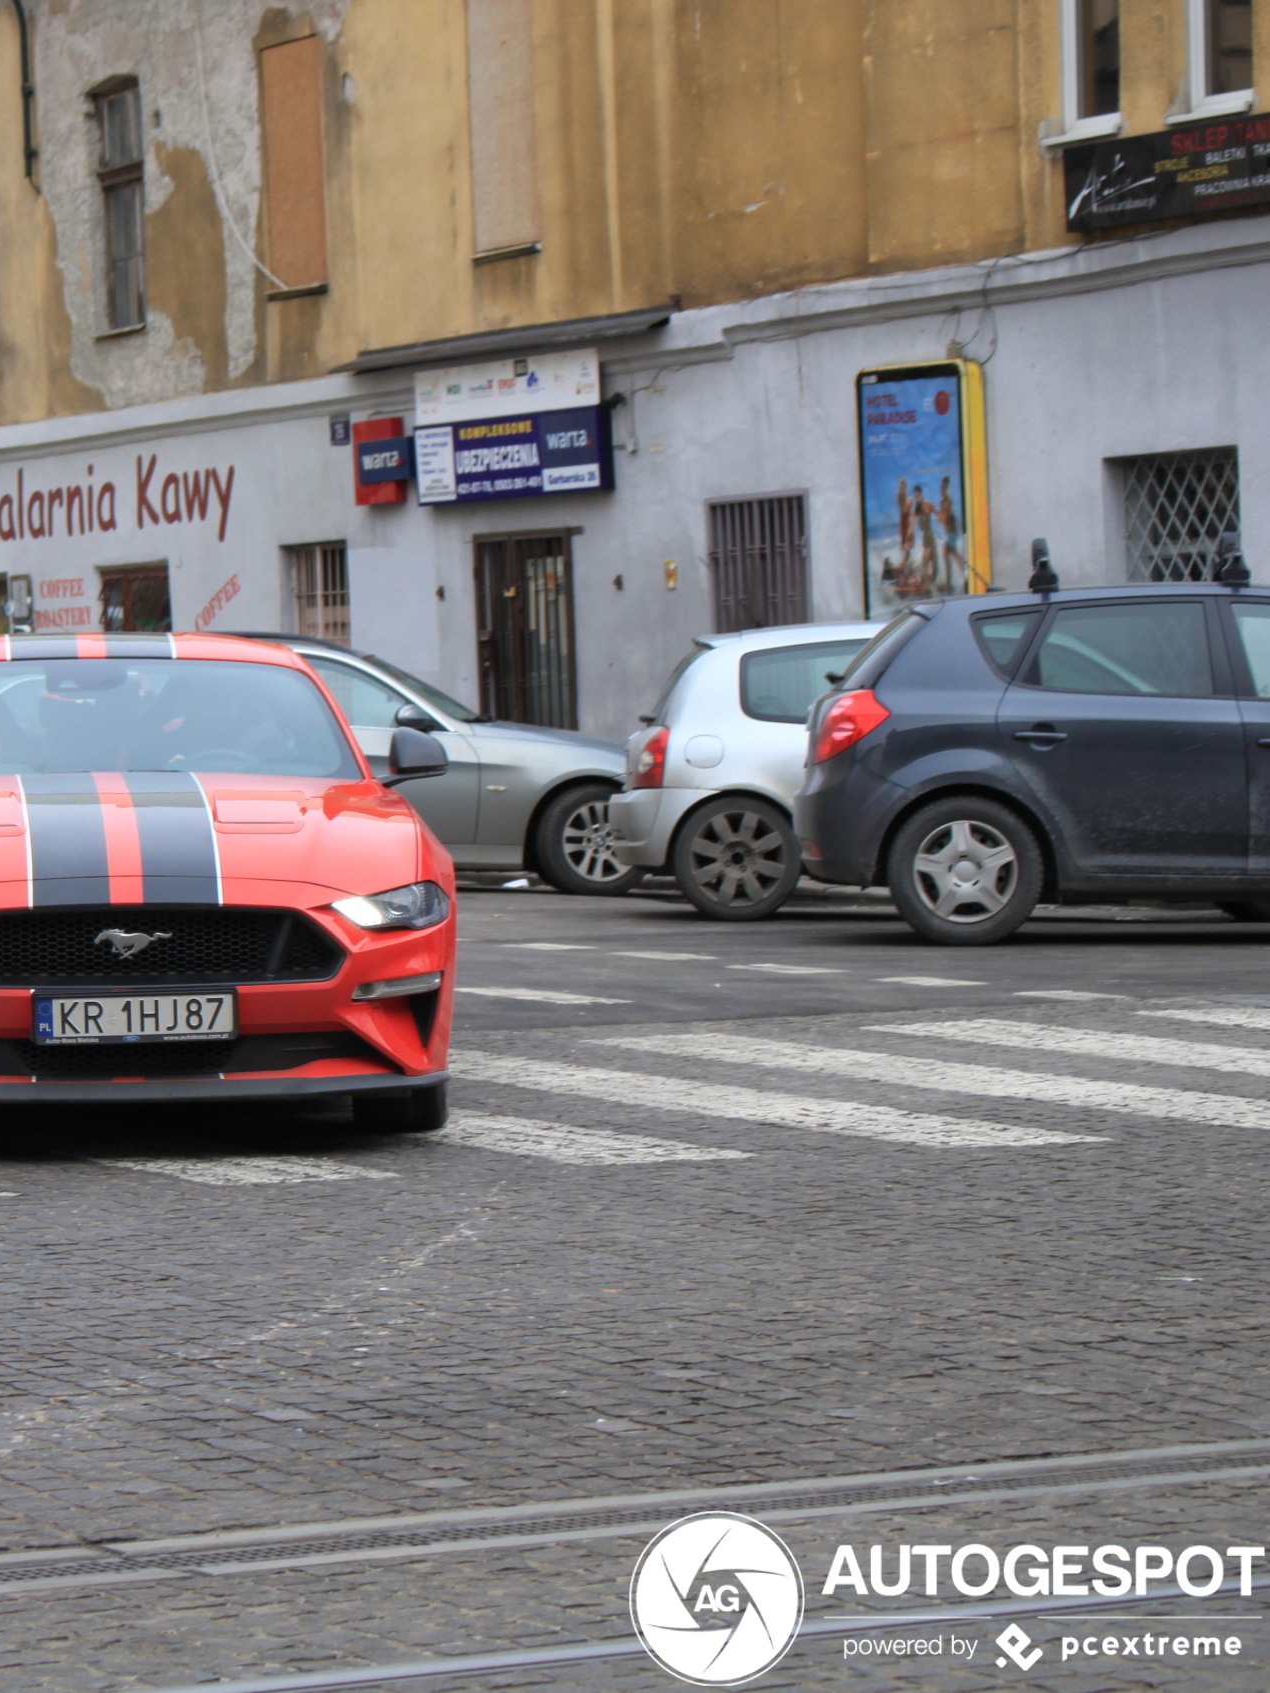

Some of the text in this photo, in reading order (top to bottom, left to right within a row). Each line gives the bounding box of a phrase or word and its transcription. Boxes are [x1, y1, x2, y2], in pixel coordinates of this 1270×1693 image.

[1171, 126, 1228, 155] SKLEP
[1205, 147, 1246, 165] BALETKI
[459, 420, 532, 440] KOMPLEKSOWE
[456, 443, 540, 475] UBEZPIECZENIA
[137, 453, 235, 542] Kawy
[40, 578, 85, 599] COFFEE
[194, 573, 242, 632] COFFEE
[35, 606, 91, 629] ROASTERY
[39, 1023, 51, 1032] PL
[60, 997, 225, 1034] KR 1HJ87
